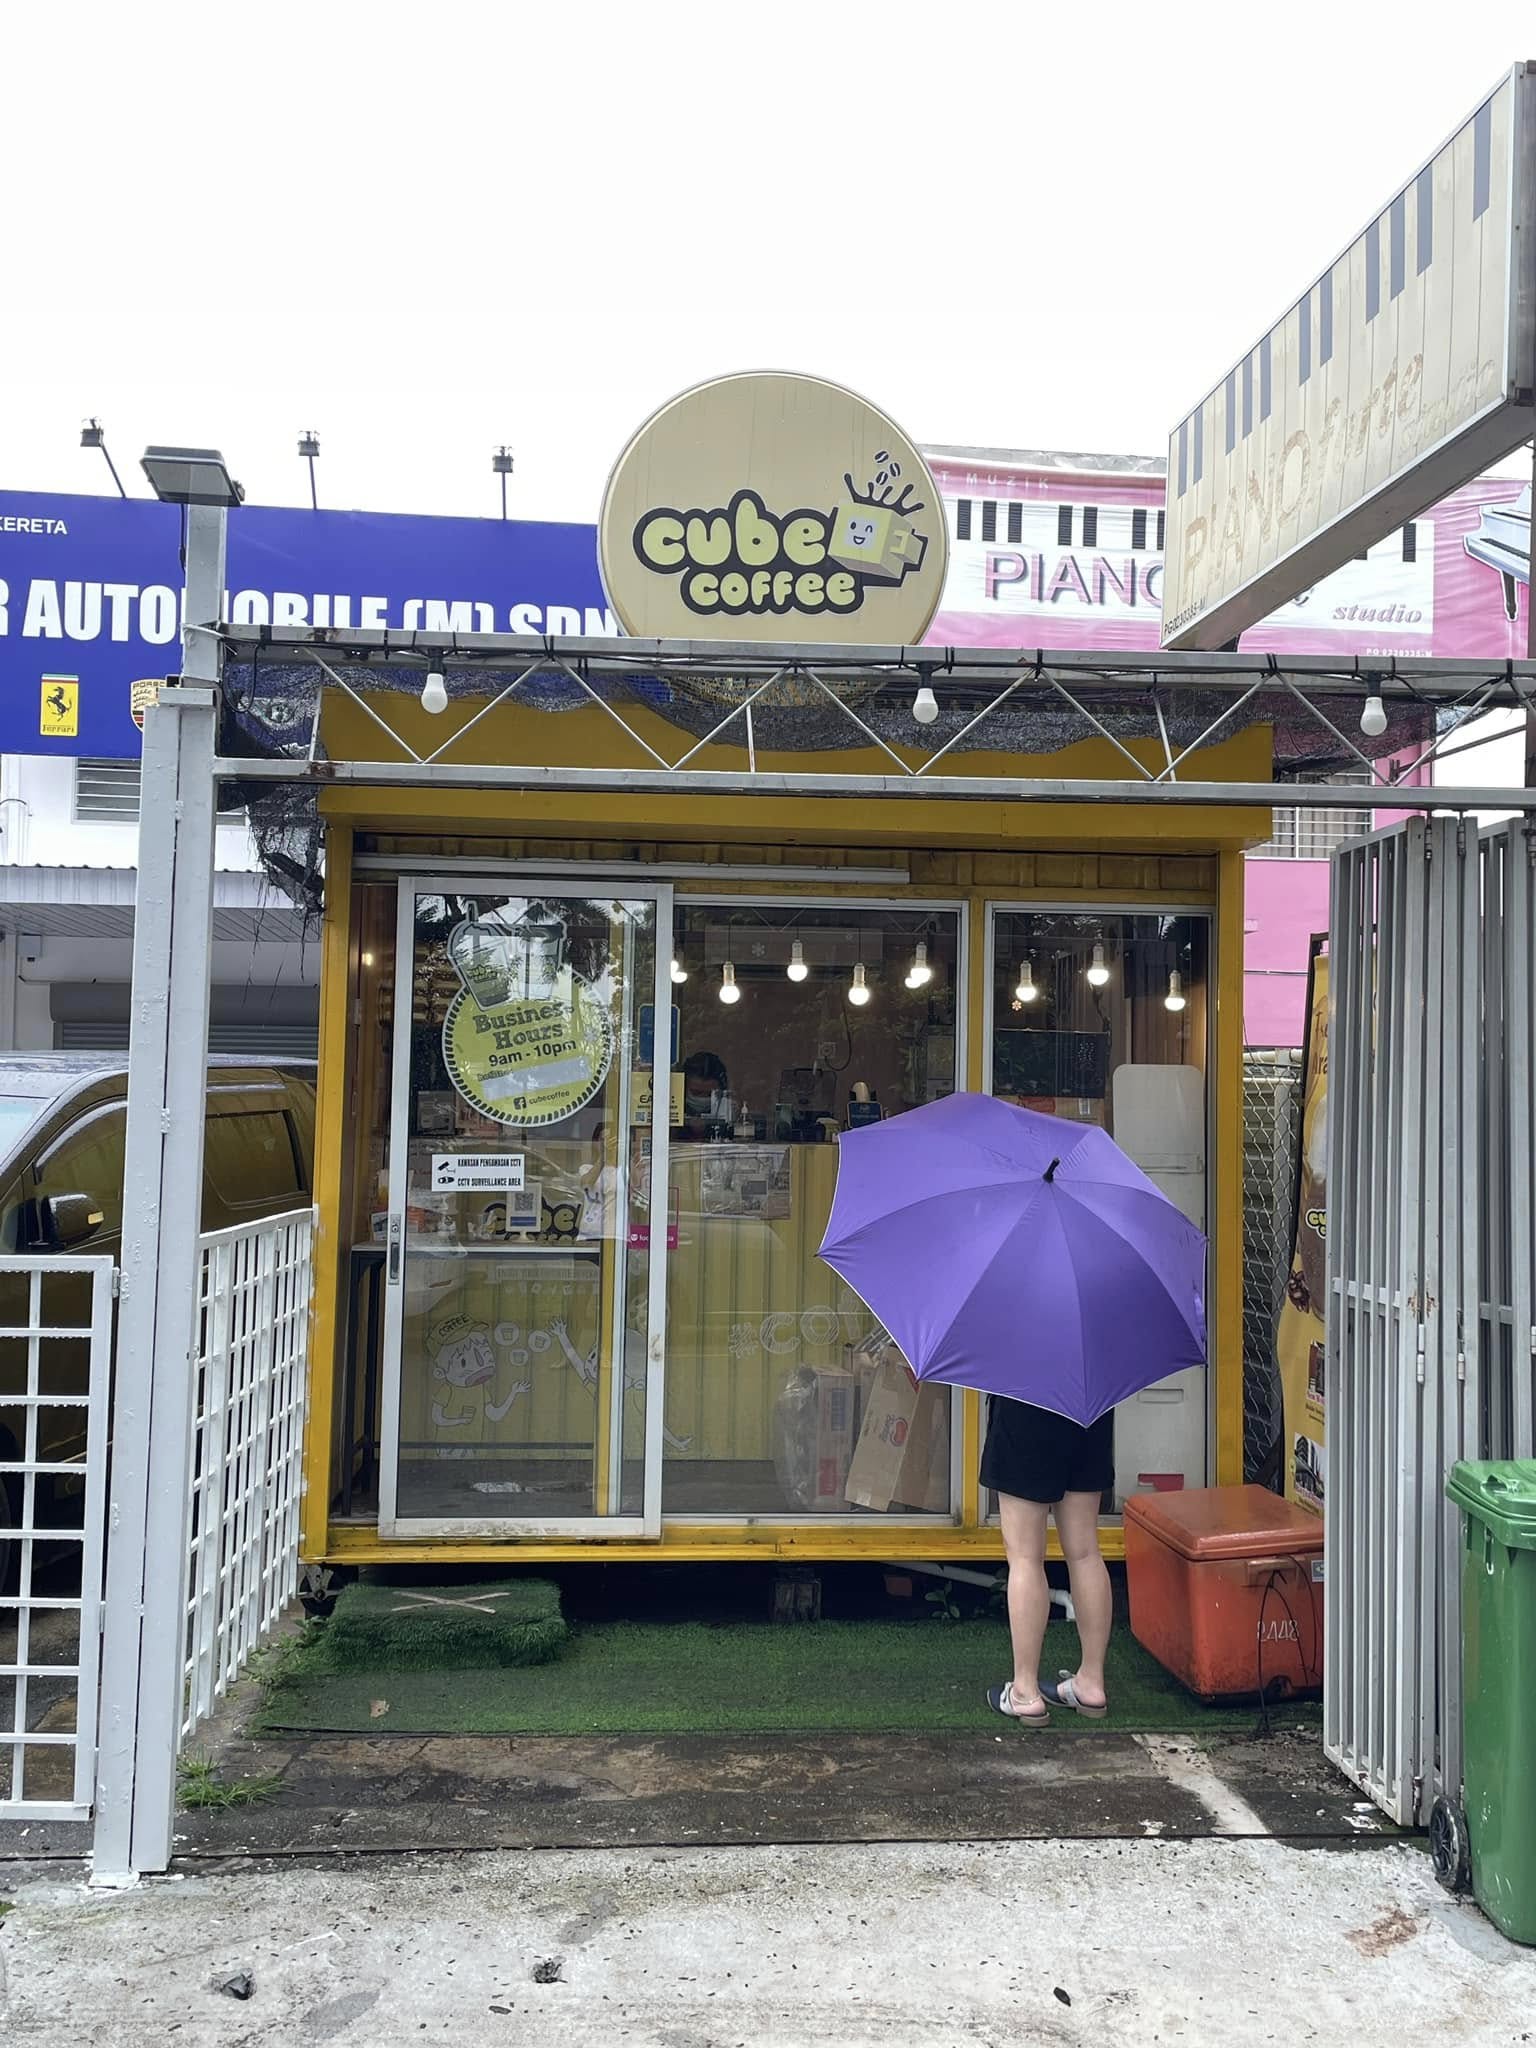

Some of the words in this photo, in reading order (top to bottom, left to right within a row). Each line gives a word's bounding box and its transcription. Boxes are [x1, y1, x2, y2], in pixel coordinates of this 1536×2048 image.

[966, 472, 1050, 489] MUZIK
[0, 517, 68, 535] ERETA
[638, 494, 829, 569] cube
[687, 569, 859, 609] coffee
[22, 579, 388, 644] AUTOOBILE
[1332, 603, 1423, 625] studio
[43, 723, 75, 733] Ferrari
[493, 1023, 563, 1050] Hours
[489, 1053, 522, 1067] 9am
[534, 1040, 577, 1058] 10pm
[529, 1089, 570, 1105] cubecoffee
[457, 1177, 470, 1187] CCTV
